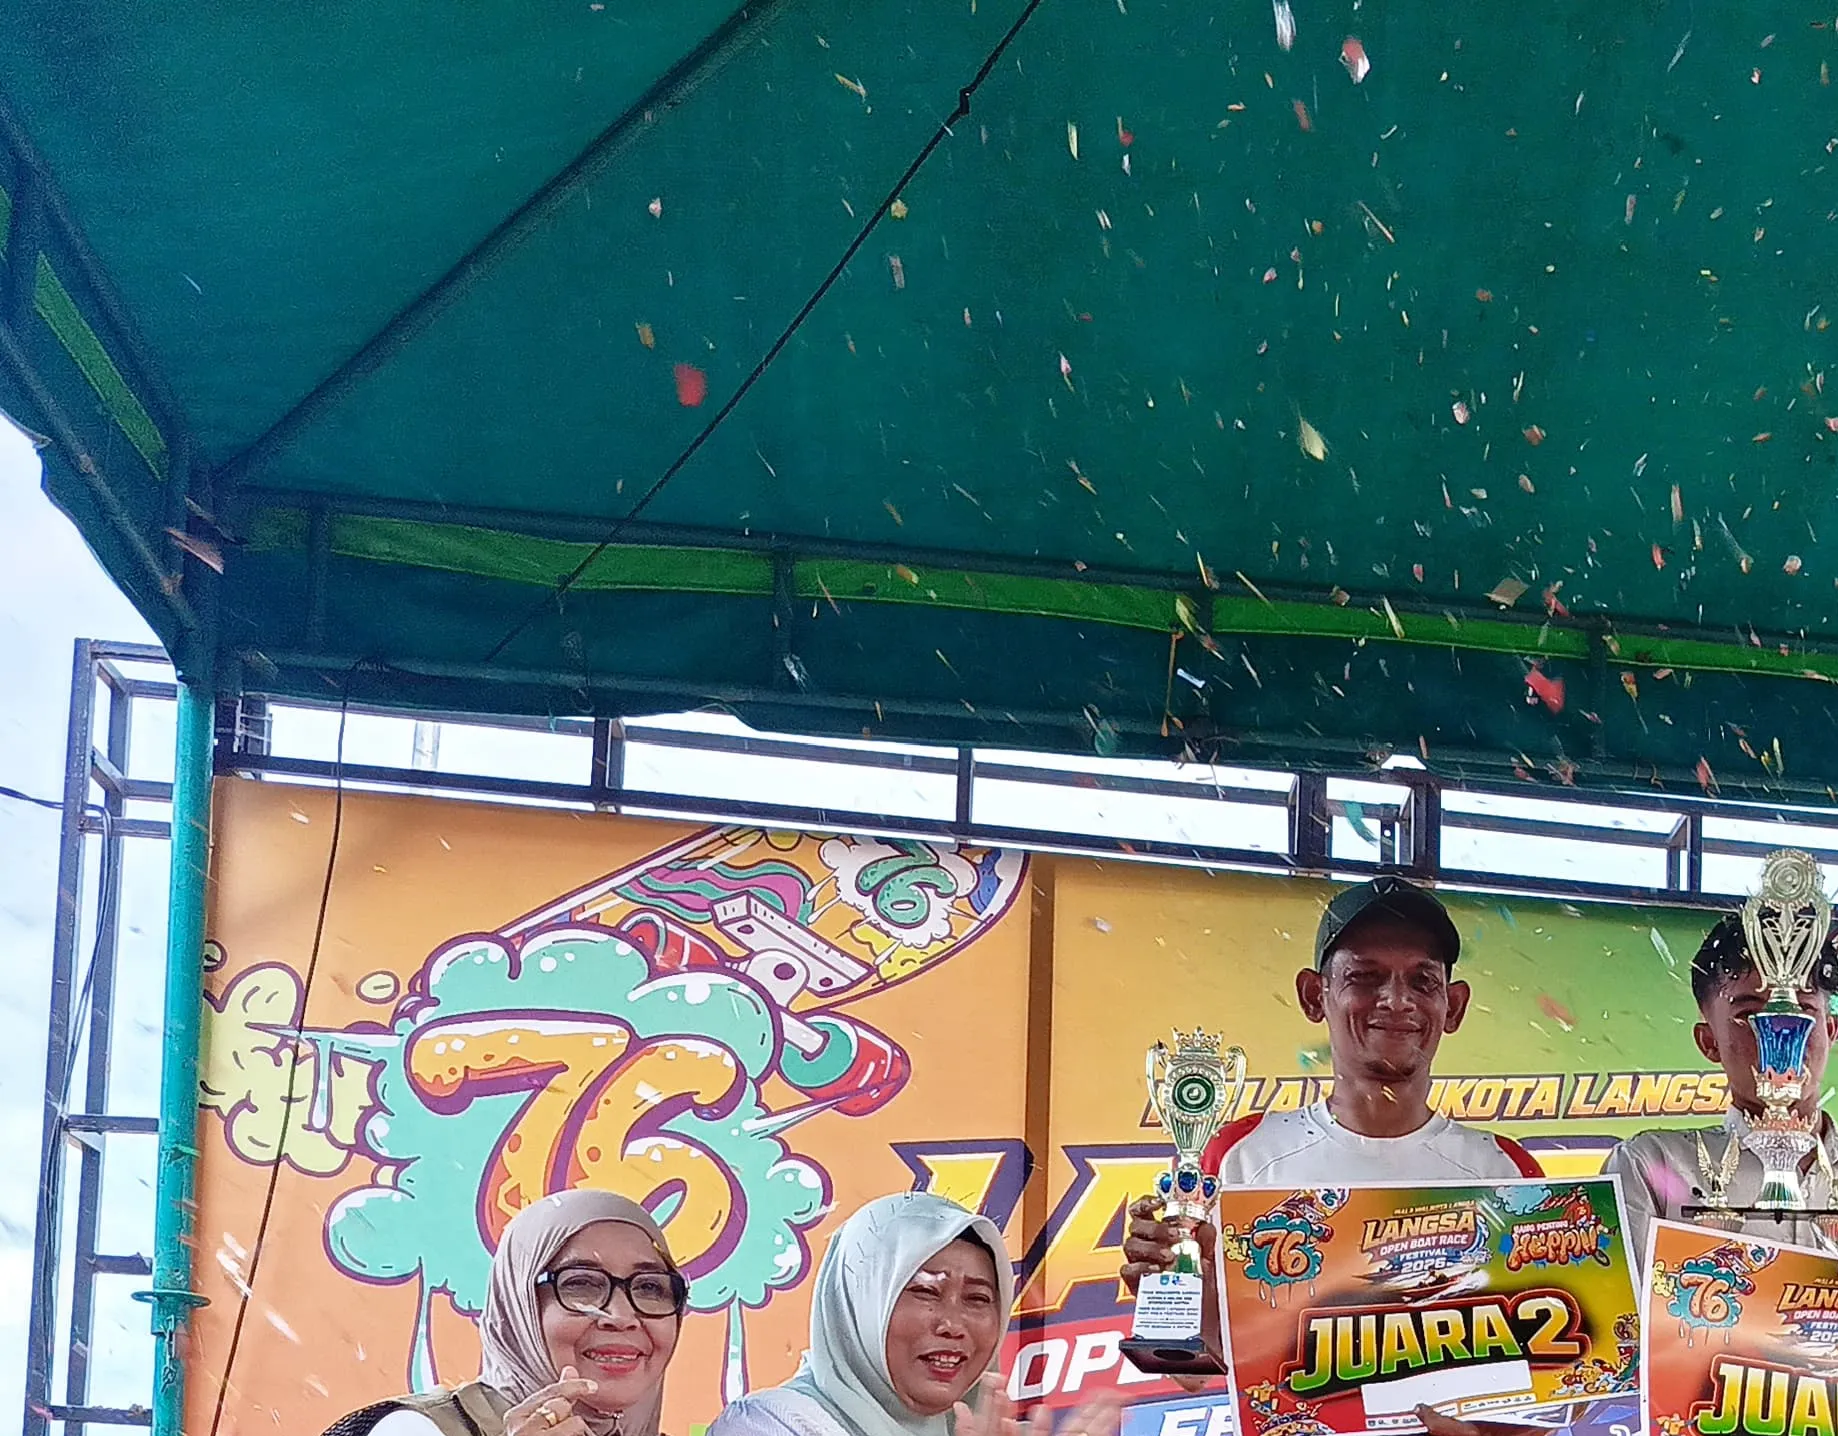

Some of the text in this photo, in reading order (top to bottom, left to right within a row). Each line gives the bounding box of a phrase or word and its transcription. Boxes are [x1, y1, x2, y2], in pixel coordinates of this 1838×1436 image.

[1426, 1075, 1734, 1120] IKOTA LANGS
[408, 1016, 748, 1276] 76
[1252, 1227, 1311, 1278] 76
[1362, 1209, 1476, 1252] LANGSA
[1379, 1233, 1469, 1257] OPEN BOAT RACE
[1399, 1247, 1448, 1261] FESTIVAL
[1680, 1272, 1730, 1322] 76
[1793, 1310, 1820, 1320] OPEN
[1289, 1296, 1581, 1392] JUARA 2
